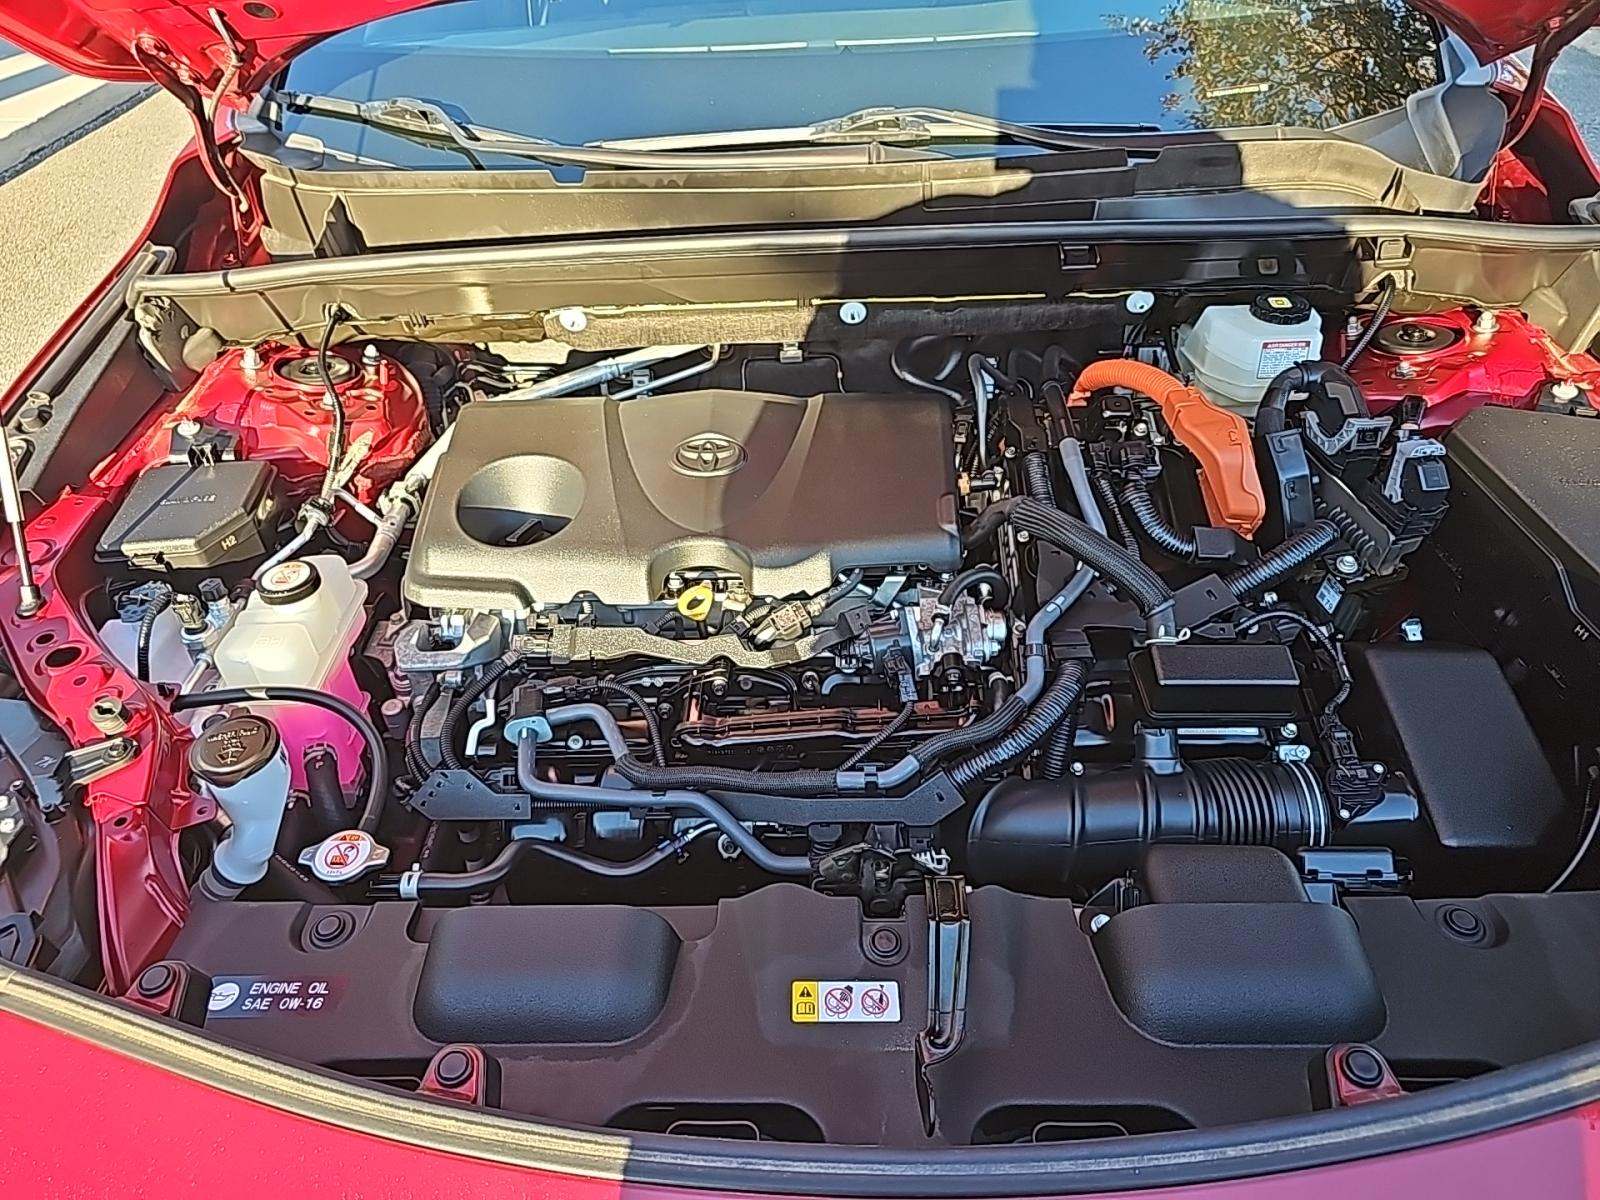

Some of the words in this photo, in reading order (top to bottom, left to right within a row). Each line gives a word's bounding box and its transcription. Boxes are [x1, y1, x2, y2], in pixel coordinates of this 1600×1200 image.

[221, 535, 238, 551] H2
[1574, 624, 1590, 641] H1
[249, 982, 302, 995] ENGINE
[307, 982, 329, 995] OIL
[241, 998, 273, 1011] SAE
[279, 997, 324, 1010] 0W-16
